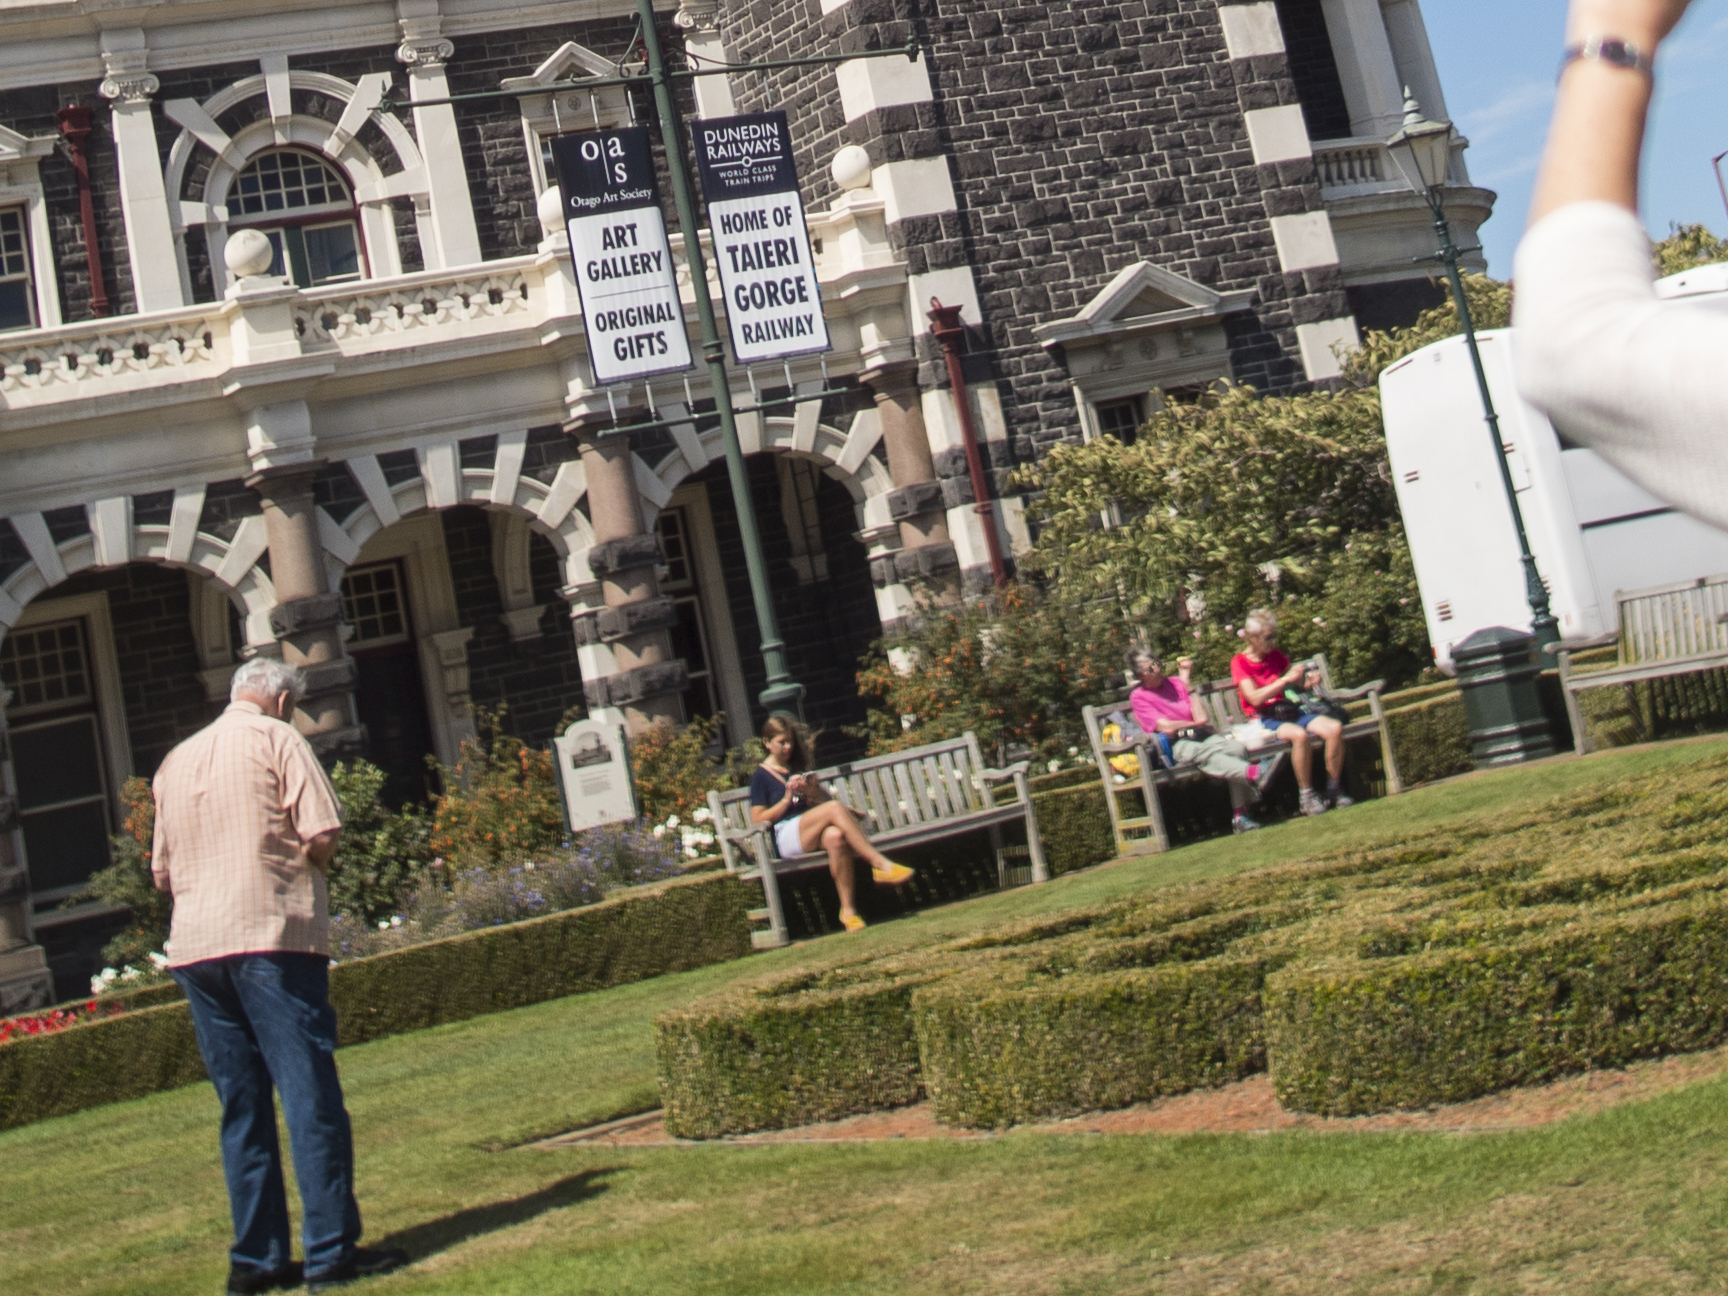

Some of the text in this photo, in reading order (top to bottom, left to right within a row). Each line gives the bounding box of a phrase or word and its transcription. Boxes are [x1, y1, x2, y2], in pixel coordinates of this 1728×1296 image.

[704, 122, 779, 144] DUNEDIN
[707, 138, 781, 160] RAILWAYS
[719, 165, 777, 179] WORLD CLASS
[725, 174, 774, 187] TRAIN TRIPS
[571, 188, 652, 208] Otago Art Society
[720, 206, 792, 235] HOME OF
[602, 223, 638, 251] ART
[587, 250, 663, 282] GALLERY
[726, 237, 799, 273] TAIERI
[734, 276, 809, 312] GORGE
[595, 302, 675, 332] ORIGINAL
[742, 313, 814, 345] RAILWAY
[614, 331, 668, 361] GIFTS
